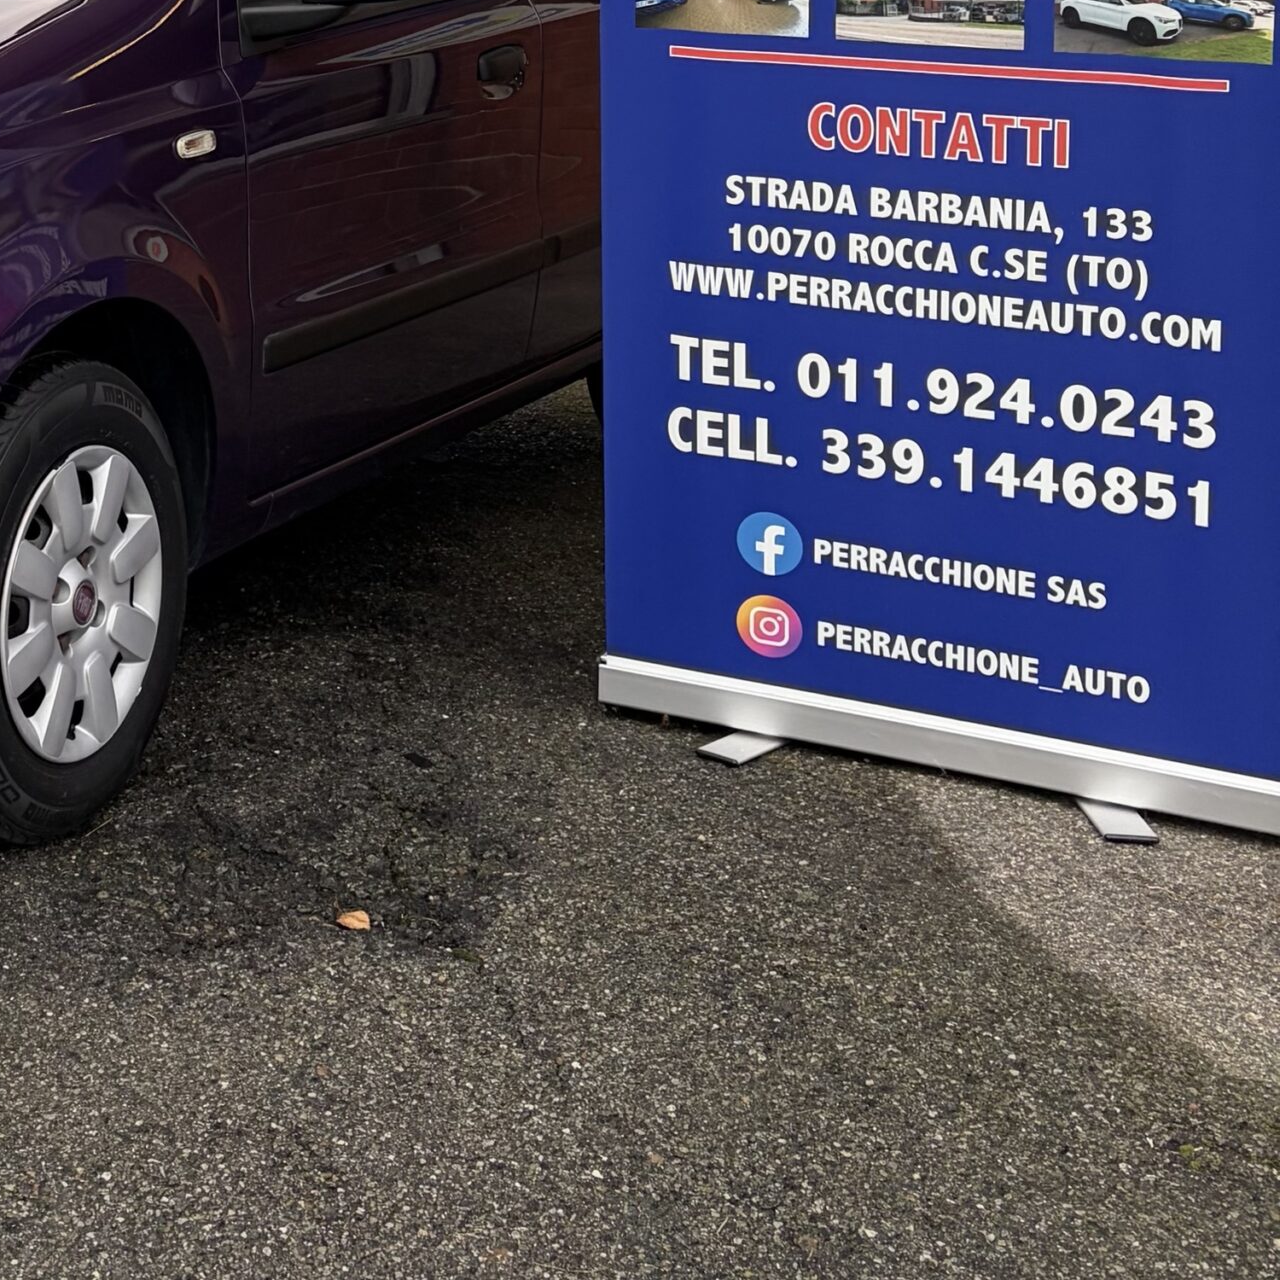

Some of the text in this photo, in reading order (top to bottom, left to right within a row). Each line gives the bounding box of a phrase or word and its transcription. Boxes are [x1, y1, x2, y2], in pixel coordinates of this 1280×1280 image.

[807, 101, 1071, 170] CONTATTI
[725, 174, 1153, 245] STRADA BARBANIA, 133
[728, 223, 1149, 301] 10070 ROCCA C.SE (TO)
[668, 260, 1223, 353] WWW.PERRACCHIONEAUTO.COM
[670, 333, 1218, 450] TEL. 011.924.0243
[667, 406, 1210, 528] CELL. 339.1446851
[813, 538, 1108, 611] PERRACCHIONE SAS
[817, 620, 1151, 704] PERRACCHIONE_AUTO
